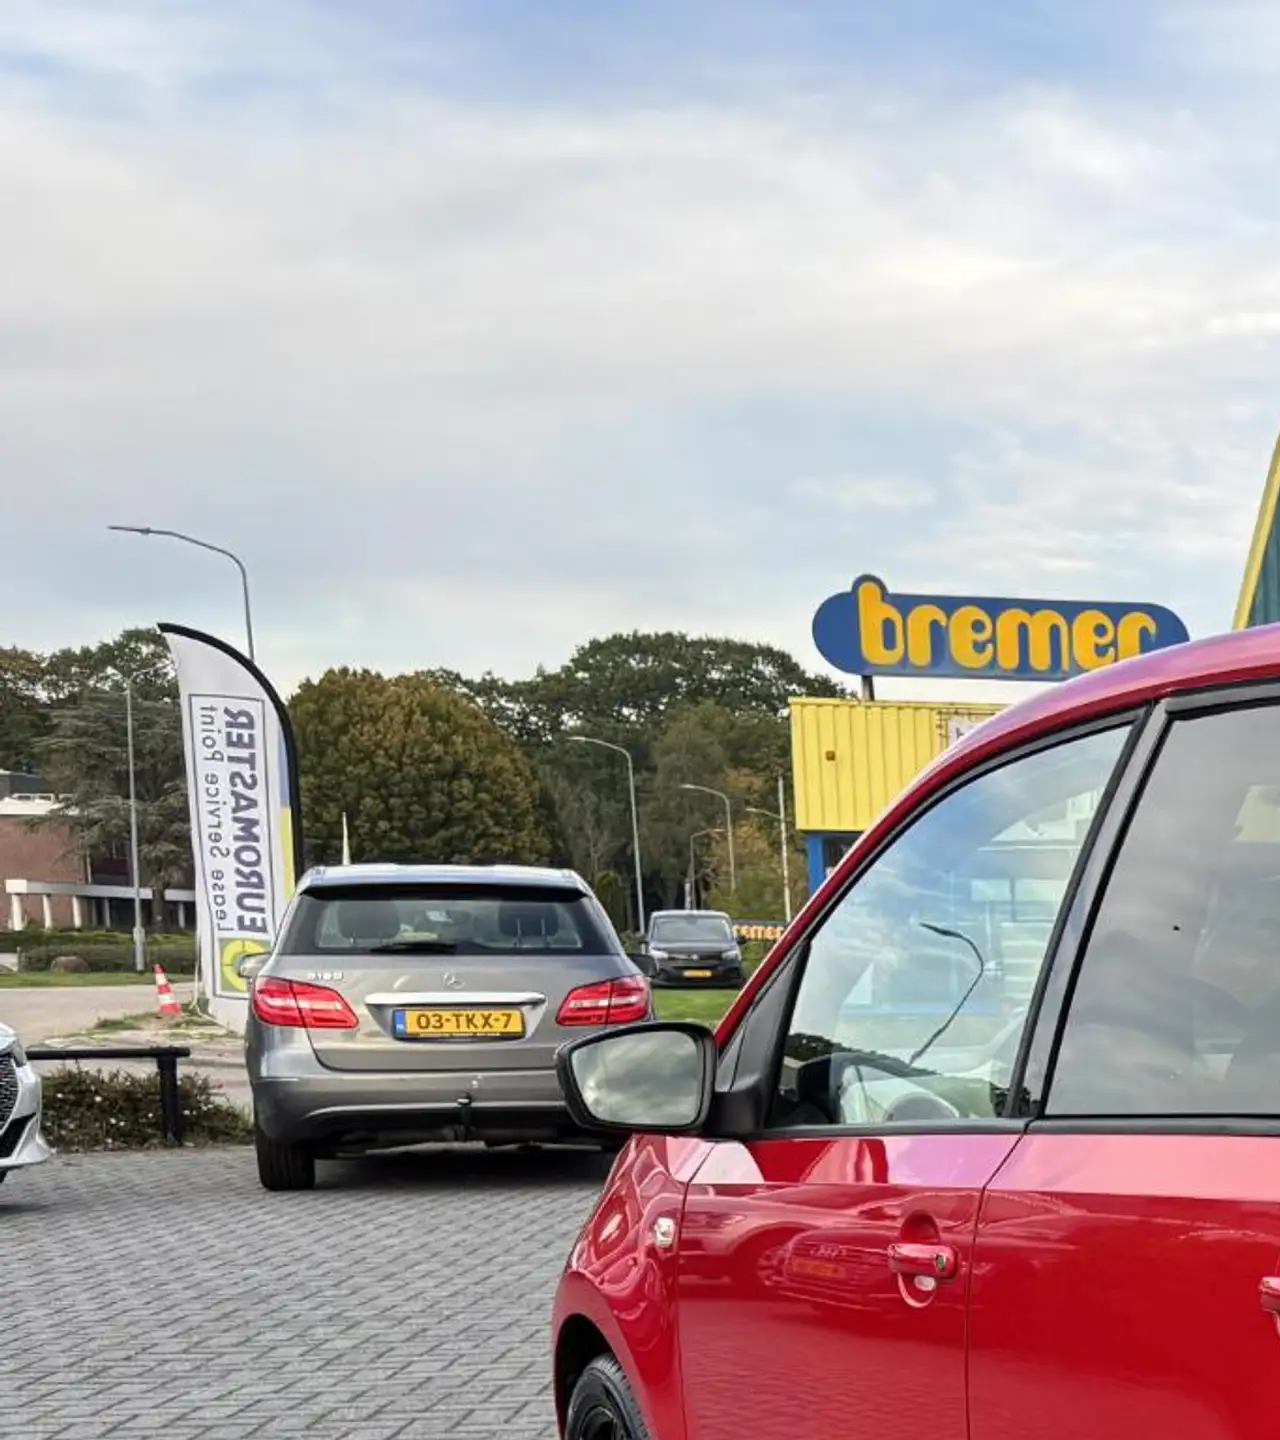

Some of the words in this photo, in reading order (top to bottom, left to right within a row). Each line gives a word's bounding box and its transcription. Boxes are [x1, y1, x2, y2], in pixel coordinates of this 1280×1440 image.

[857, 581, 1157, 672] bremer
[732, 924, 785, 941] remer
[416, 1012, 513, 1030] 03-TKX-7
